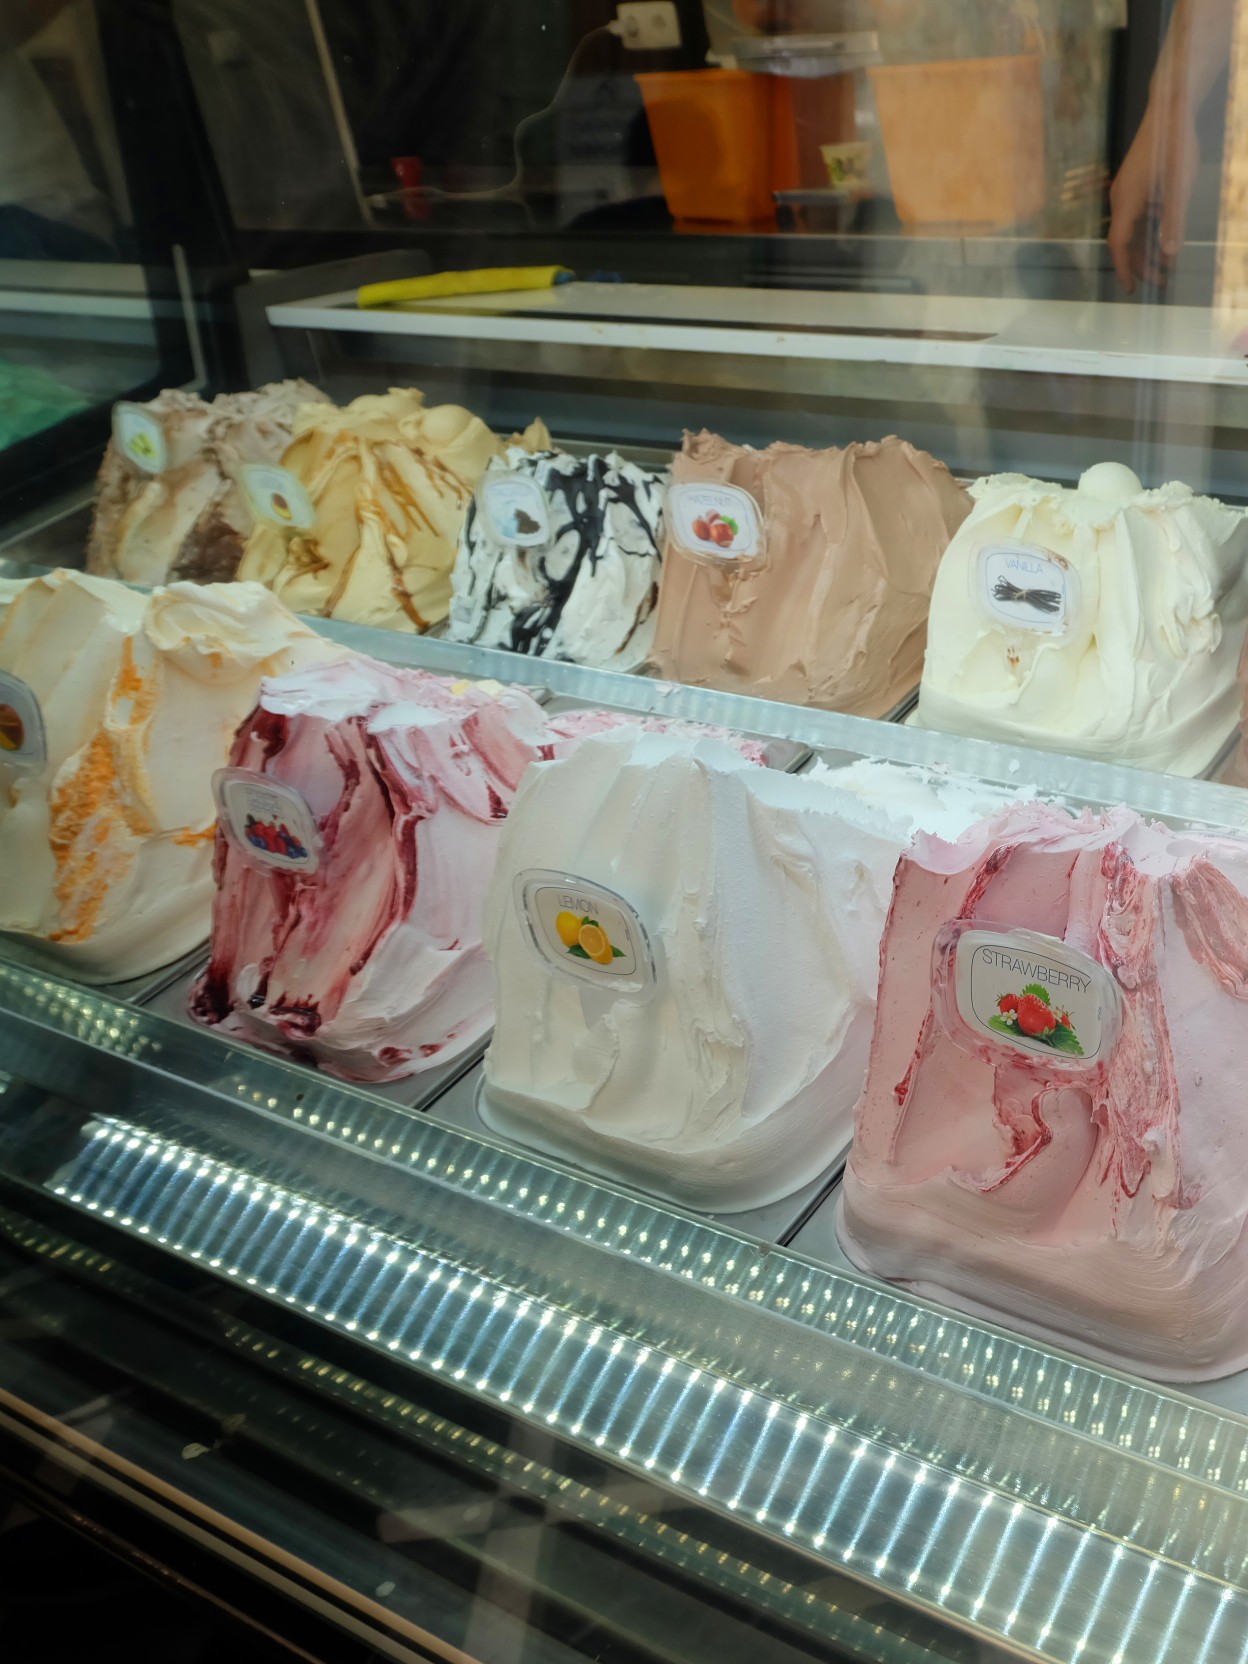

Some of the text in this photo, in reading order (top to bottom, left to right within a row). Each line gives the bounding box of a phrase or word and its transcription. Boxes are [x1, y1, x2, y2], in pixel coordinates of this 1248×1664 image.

[1005, 558, 1044, 574] VANILLA
[558, 895, 599, 914] LEMON
[982, 949, 1091, 993] STRAWBERRY
